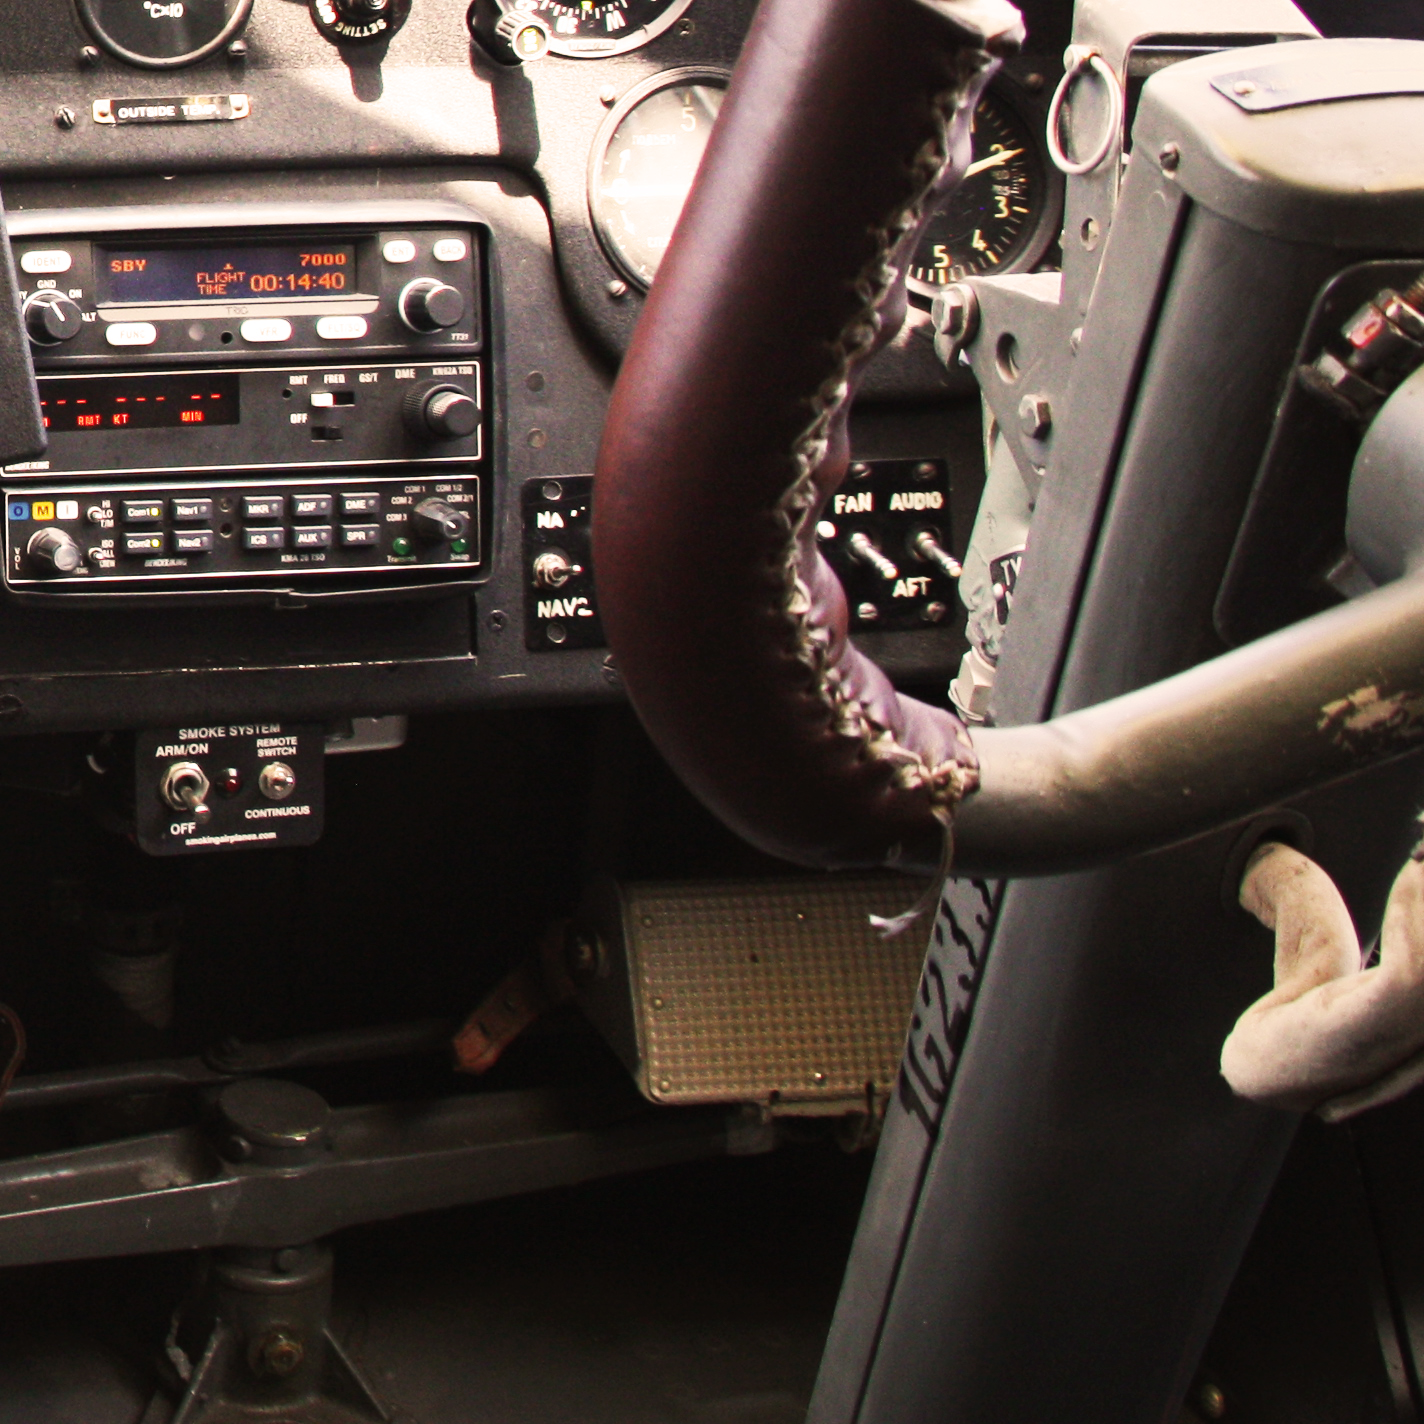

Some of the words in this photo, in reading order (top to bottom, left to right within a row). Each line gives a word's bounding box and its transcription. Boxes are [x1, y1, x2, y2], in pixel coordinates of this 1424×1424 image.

[118, 104, 175, 120] OUTSIDE
[33, 257, 62, 267] IDENT
[110, 259, 147, 273] SBY
[299, 253, 346, 266] 7000
[196, 271, 246, 284] FLIGHT
[250, 272, 345, 292] 00:14:40
[197, 283, 227, 295] TIME
[181, 411, 203, 422] MIN
[290, 413, 308, 424] OFF
[297, 502, 316, 512] ADF
[345, 500, 366, 510] DME
[890, 491, 944, 511] AUDIO
[298, 533, 318, 543] AUX
[347, 531, 365, 541] SPR
[892, 577, 931, 598] AFT
[537, 597, 593, 619] NAV2
[179, 726, 226, 741] SMOKE
[229, 723, 281, 737] SYSTEM
[256, 737, 297, 749] REMOTE
[155, 743, 209, 757] ARM/ON
[257, 746, 297, 758] SWITCH
[245, 805, 311, 820] CONTINUOUS
[170, 822, 197, 836] OFF
[185, 831, 277, 847] smokingairplanes.com
